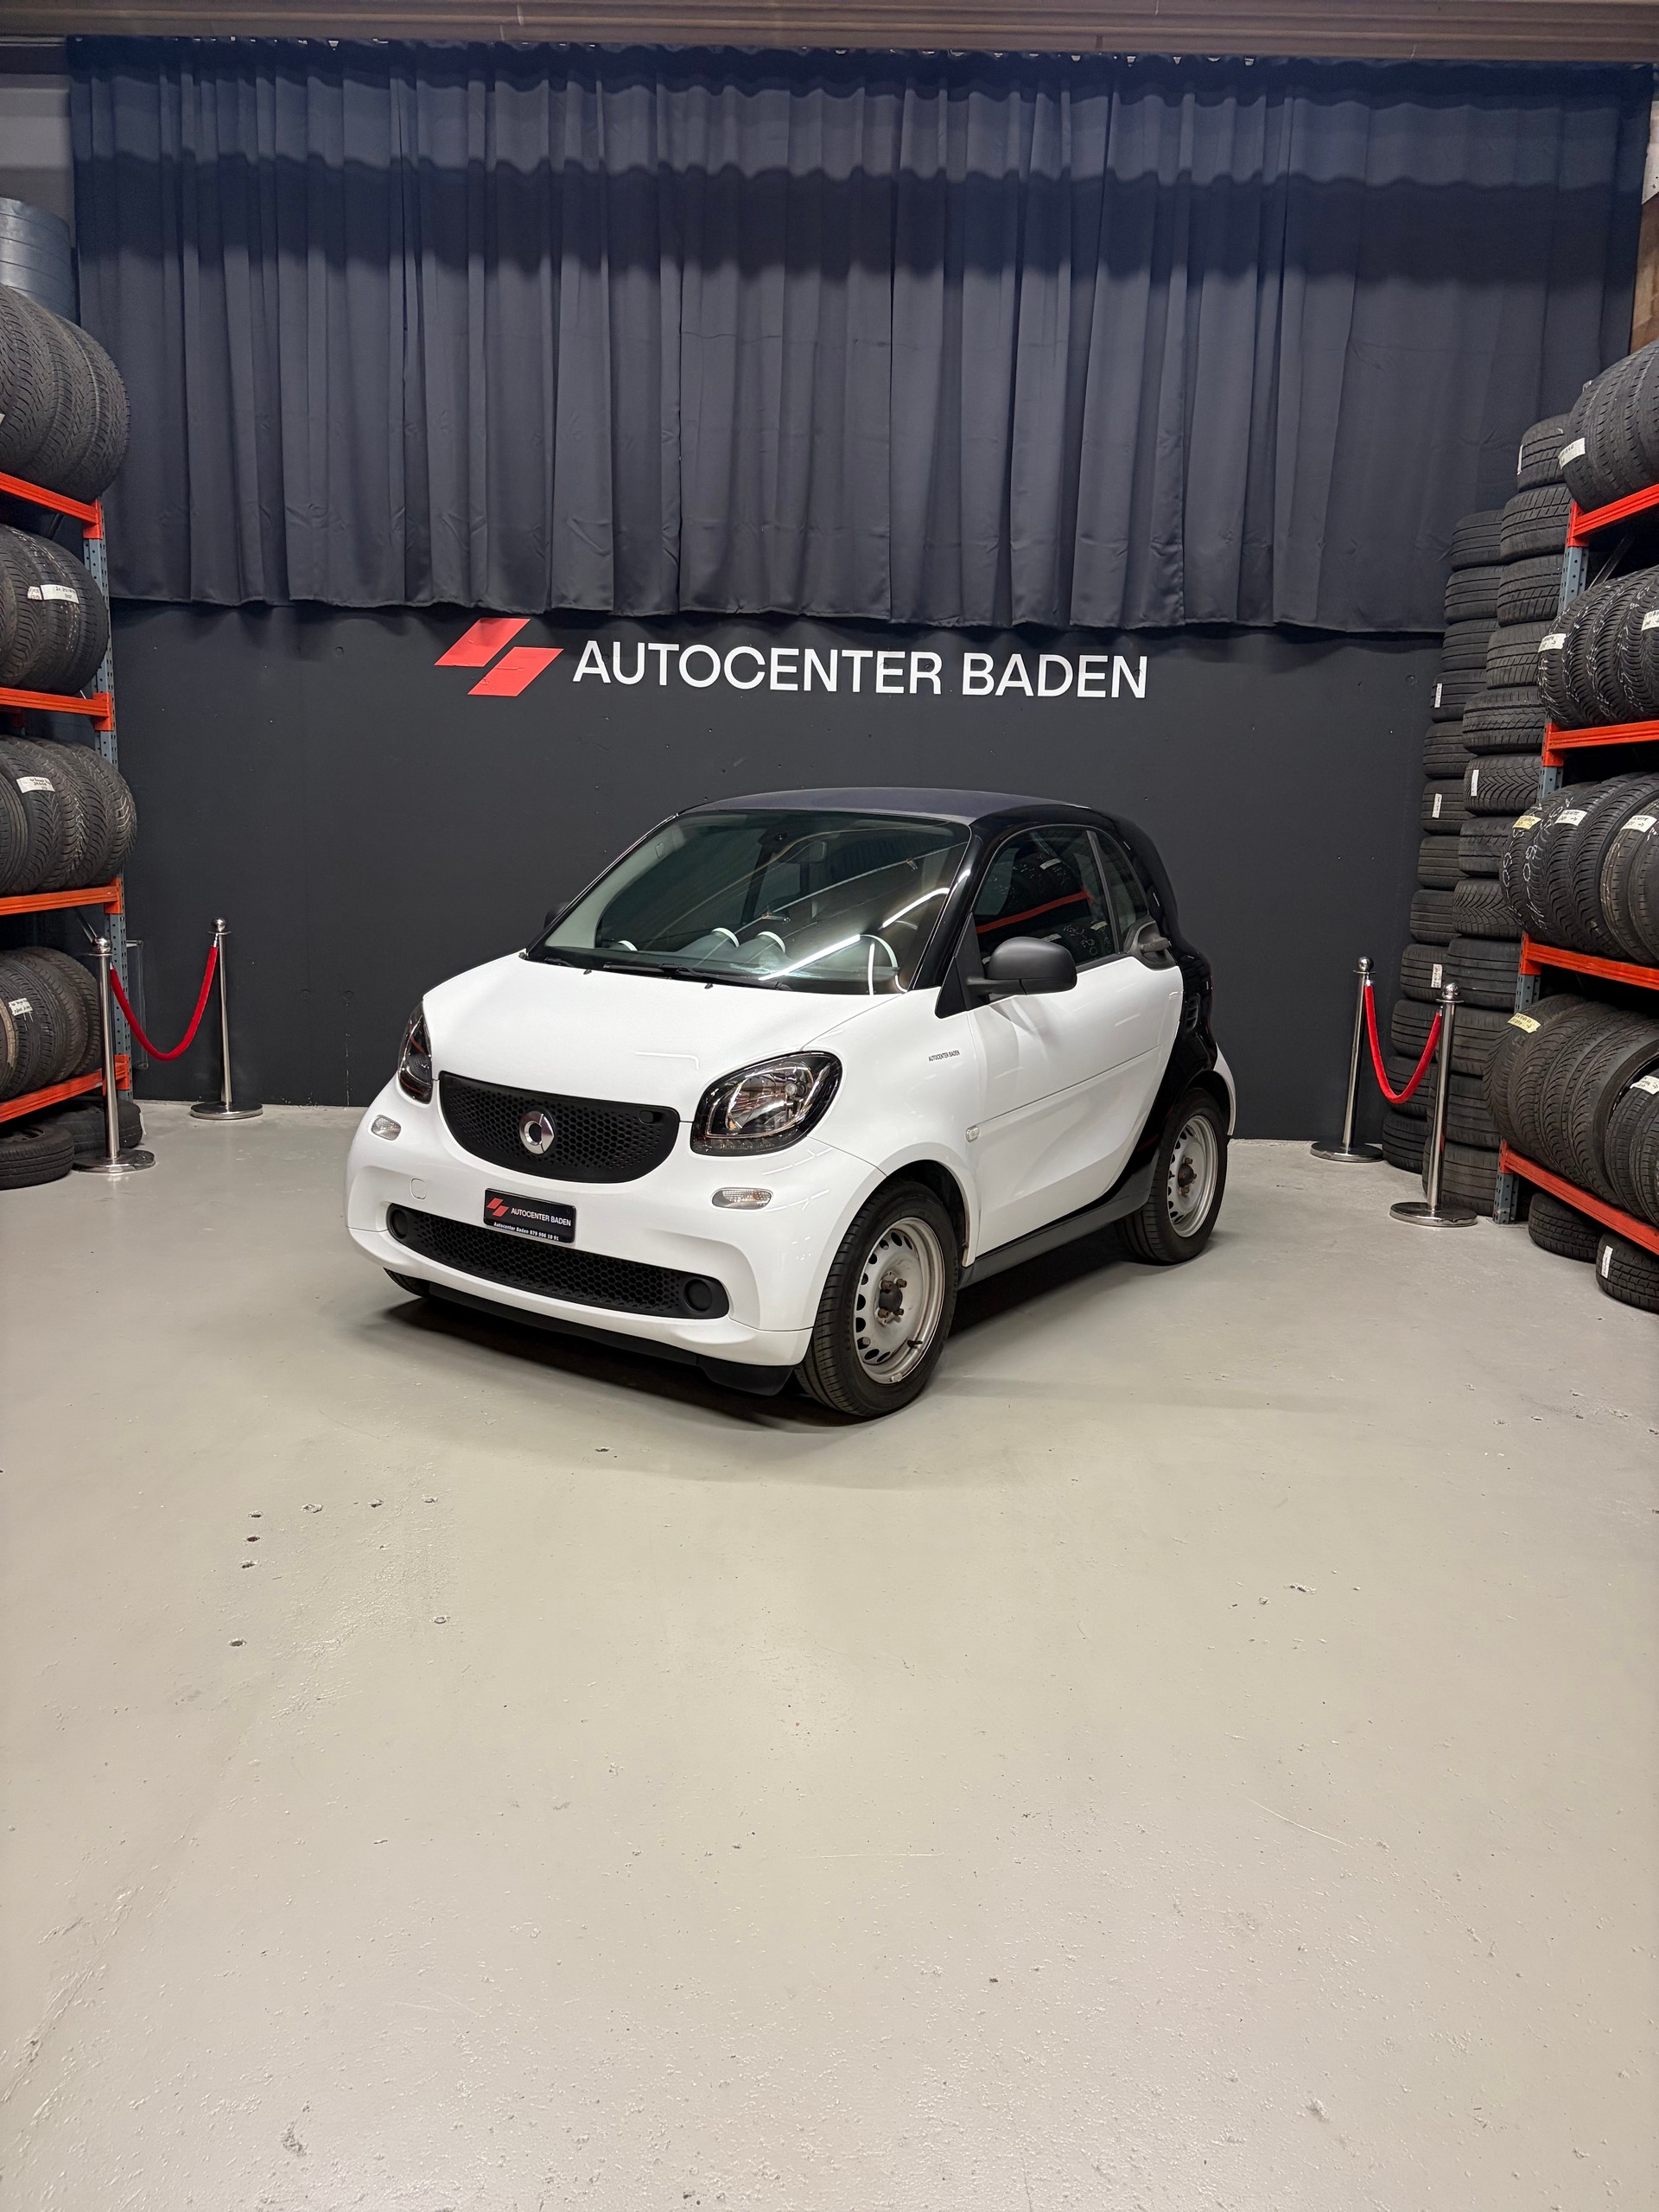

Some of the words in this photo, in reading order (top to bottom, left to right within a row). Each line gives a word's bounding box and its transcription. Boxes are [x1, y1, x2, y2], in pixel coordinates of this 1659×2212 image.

[572, 640, 942, 696] AUTOCENTER
[961, 652, 1147, 699] BADEN
[928, 1052, 949, 1061] AUTOCENTER
[511, 1208, 550, 1222] AUTOCENTER
[550, 1216, 571, 1226] BADEN
[493, 1222, 515, 1230] Autocenter
